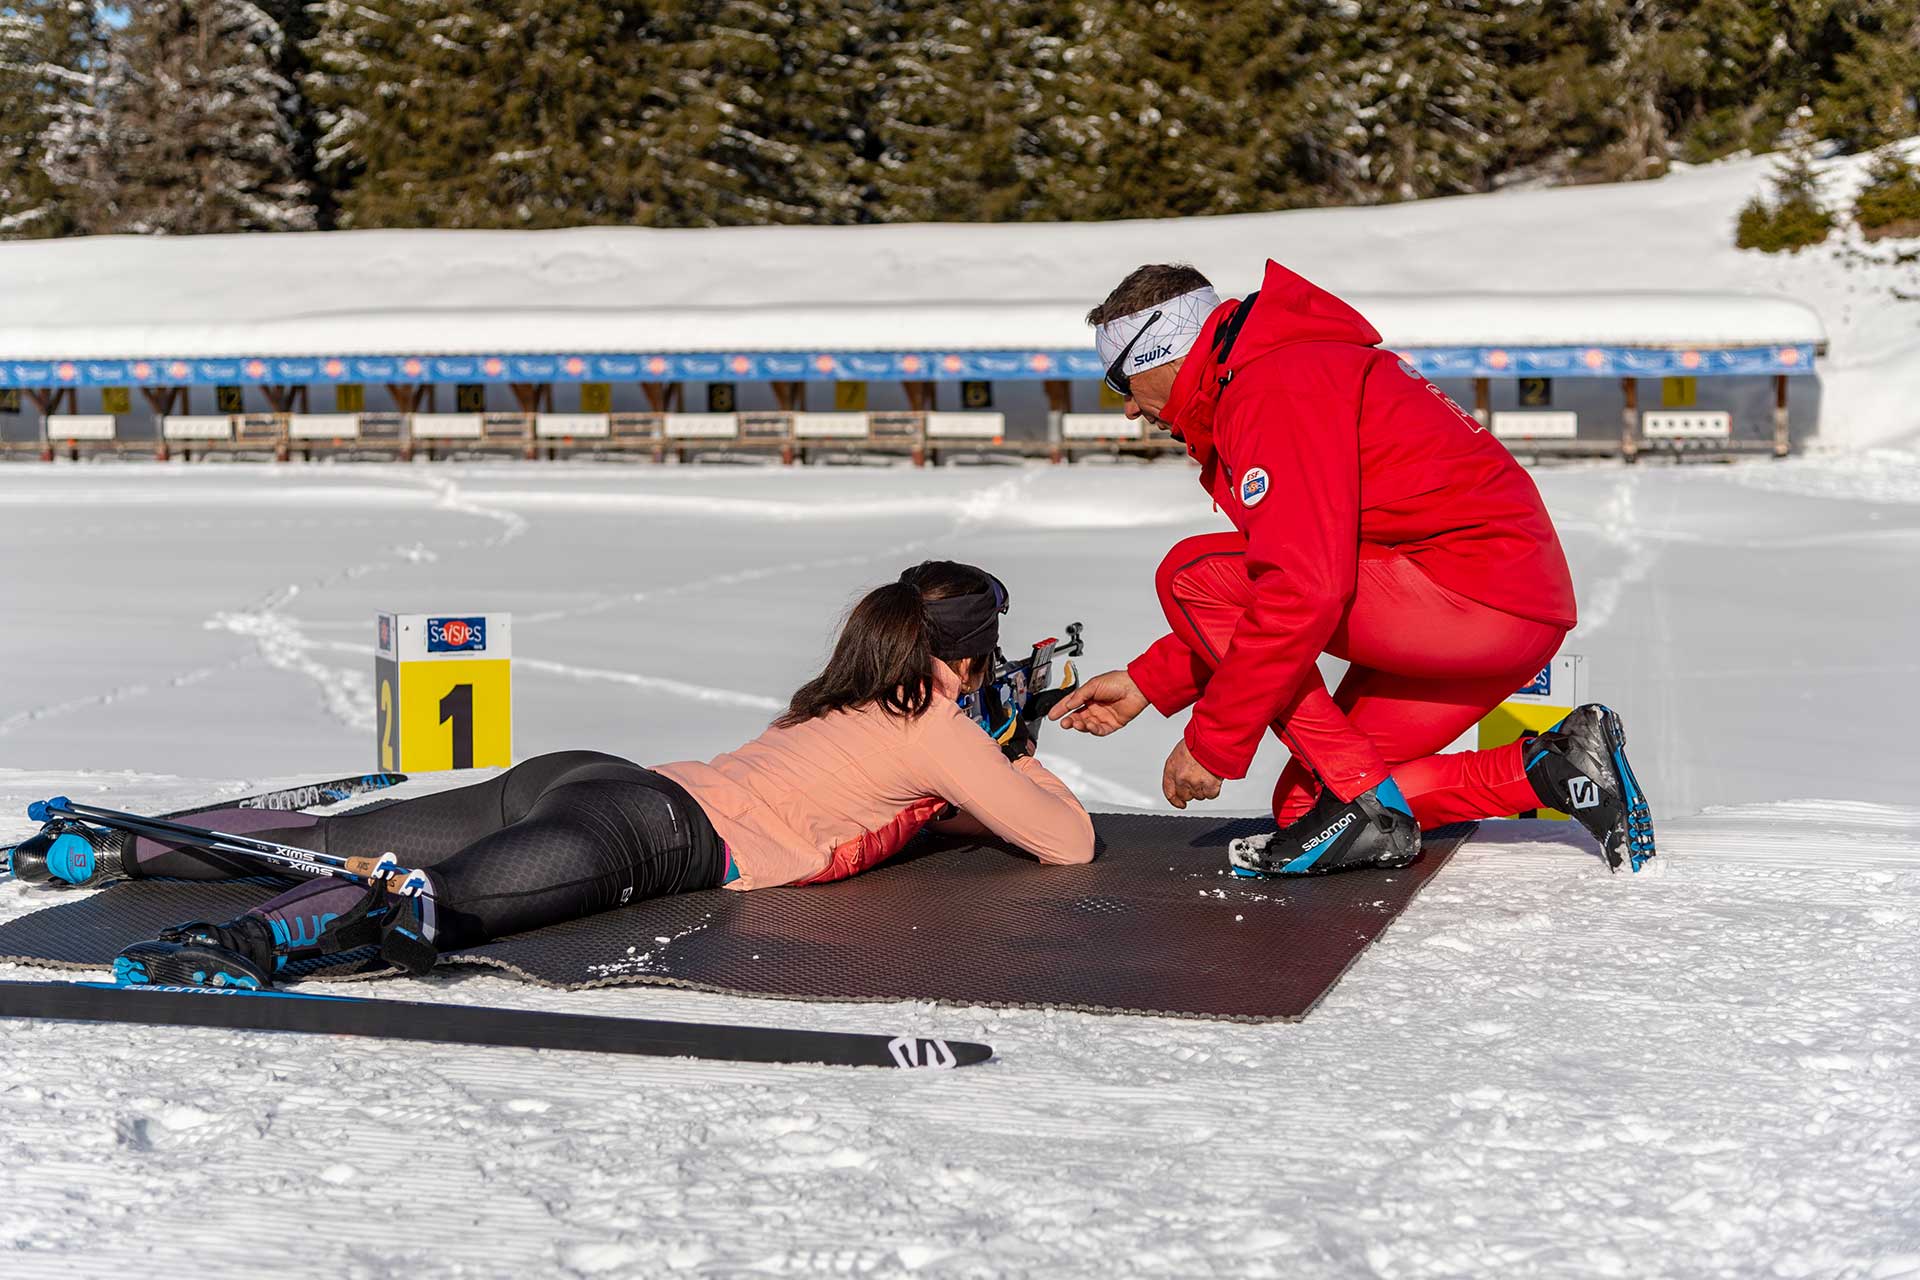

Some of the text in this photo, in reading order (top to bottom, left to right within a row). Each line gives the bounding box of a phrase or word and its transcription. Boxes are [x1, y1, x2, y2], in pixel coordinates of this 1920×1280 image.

[1523, 378, 1545, 406] 2
[381, 679, 393, 771] 2
[439, 684, 474, 770] 1
[1302, 812, 1357, 852] salomon
